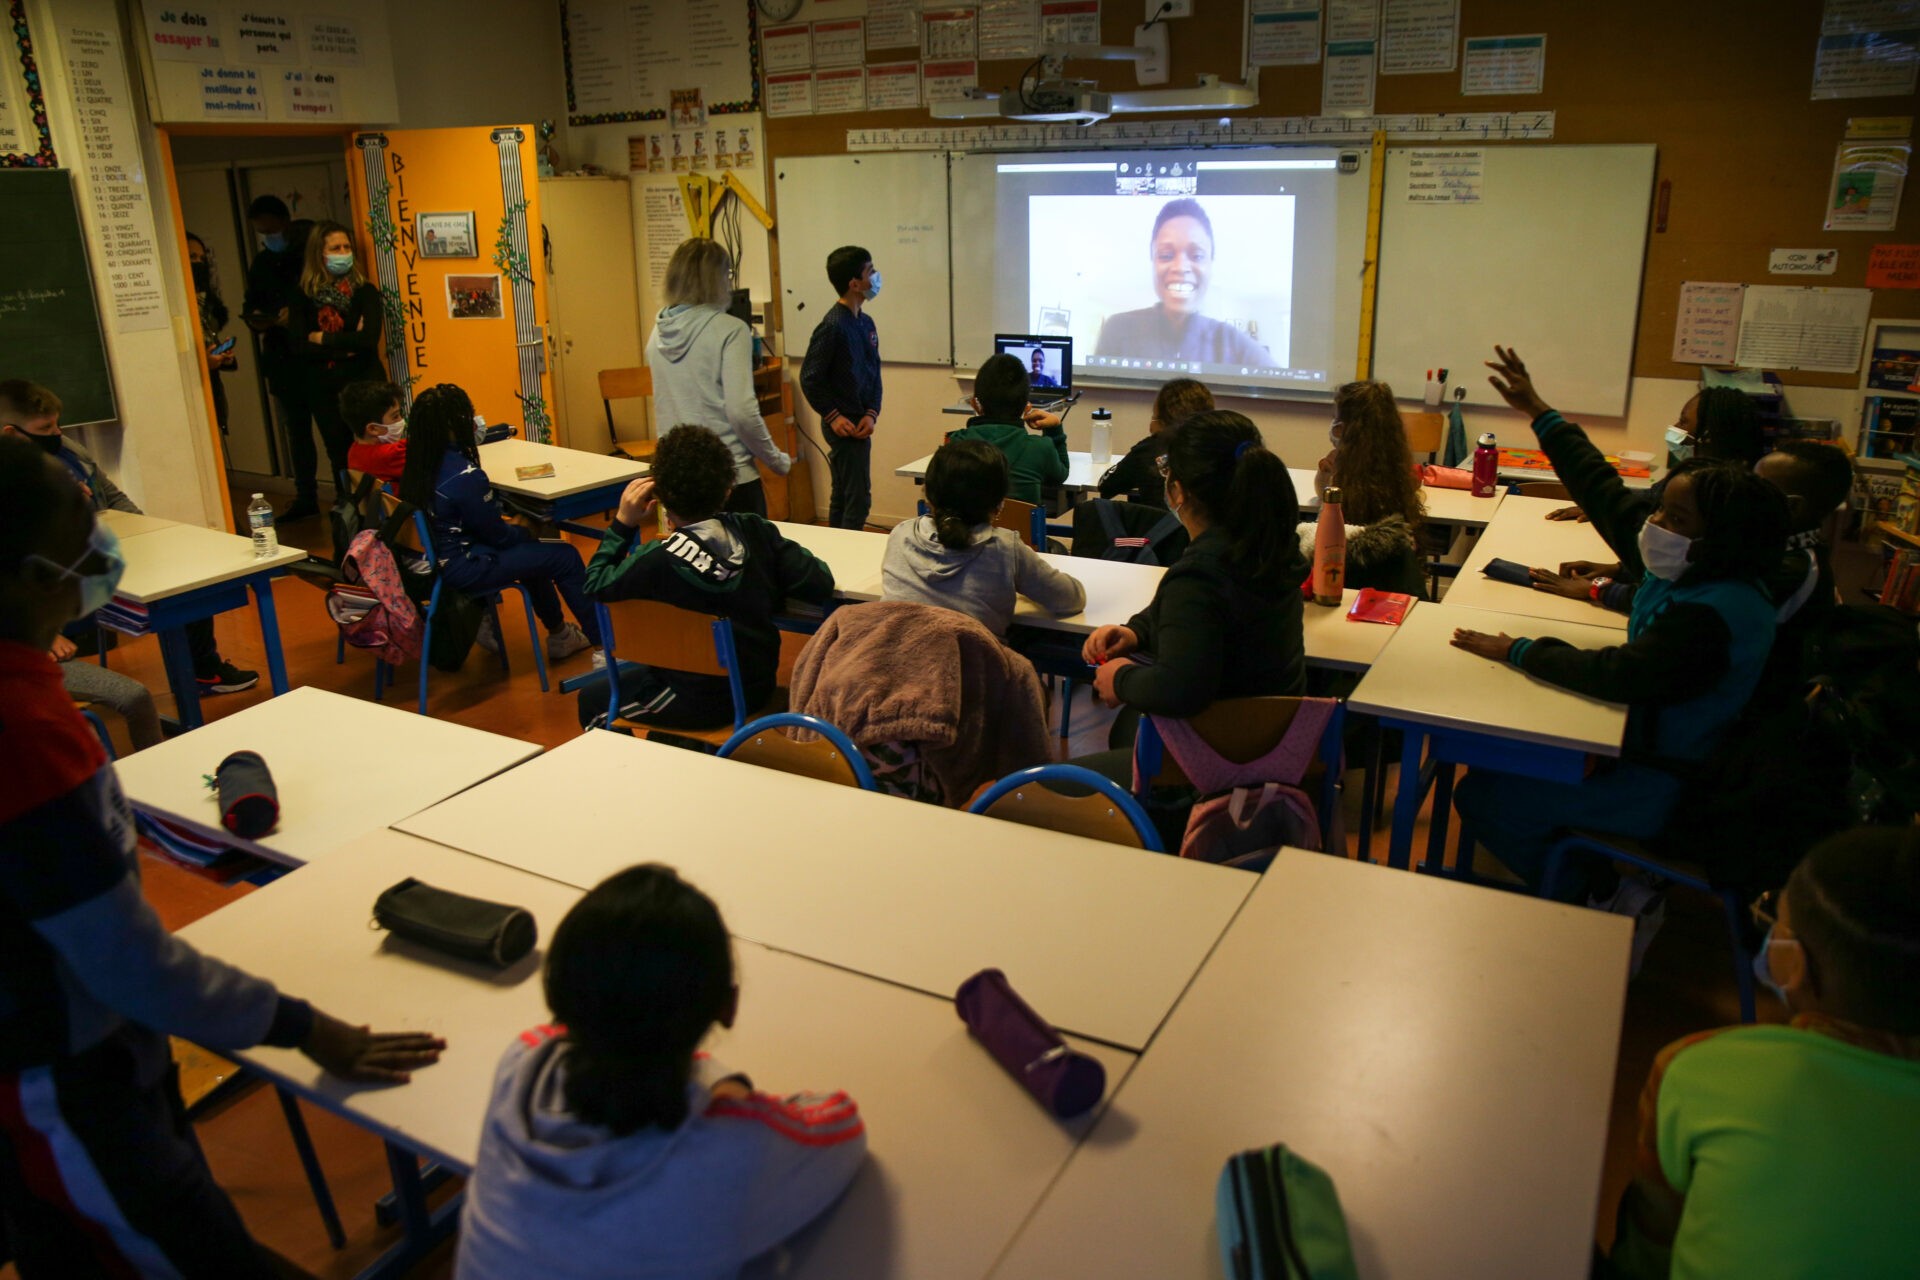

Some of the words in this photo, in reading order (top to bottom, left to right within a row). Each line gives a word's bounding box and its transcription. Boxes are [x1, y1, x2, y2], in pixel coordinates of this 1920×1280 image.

[160, 11, 176, 23] Je
[181, 12, 208, 26] dois
[239, 28, 276, 40] personne
[279, 31, 292, 41] qui
[154, 32, 202, 50] essayer
[202, 69, 214, 79] Je
[217, 69, 244, 79] donne
[315, 74, 335, 84] droit
[85, 87, 105, 95] TROIS
[205, 84, 242, 95] meilleur
[87, 96, 113, 104] QUATRE
[205, 100, 255, 111] moi-même
[293, 104, 326, 115] tromper
[89, 109, 107, 118] CINQ
[92, 126, 109, 134] SEPT
[101, 152, 113, 160] DIX
[109, 194, 142, 202] QUATORZE
[111, 203, 134, 211] QUINZE
[112, 211, 130, 219] SEIZE
[115, 224, 134, 232] VINGT
[116, 232, 140, 240] TRENTE
[118, 240, 151, 249] QUARANTE
[122, 258, 152, 268] SOIXANTE
[392, 152, 428, 367] BIENVENUE
[1772, 263, 1823, 271] AUTONOMIE
[128, 272, 144, 280] CENT
[133, 280, 151, 288] MILLE
